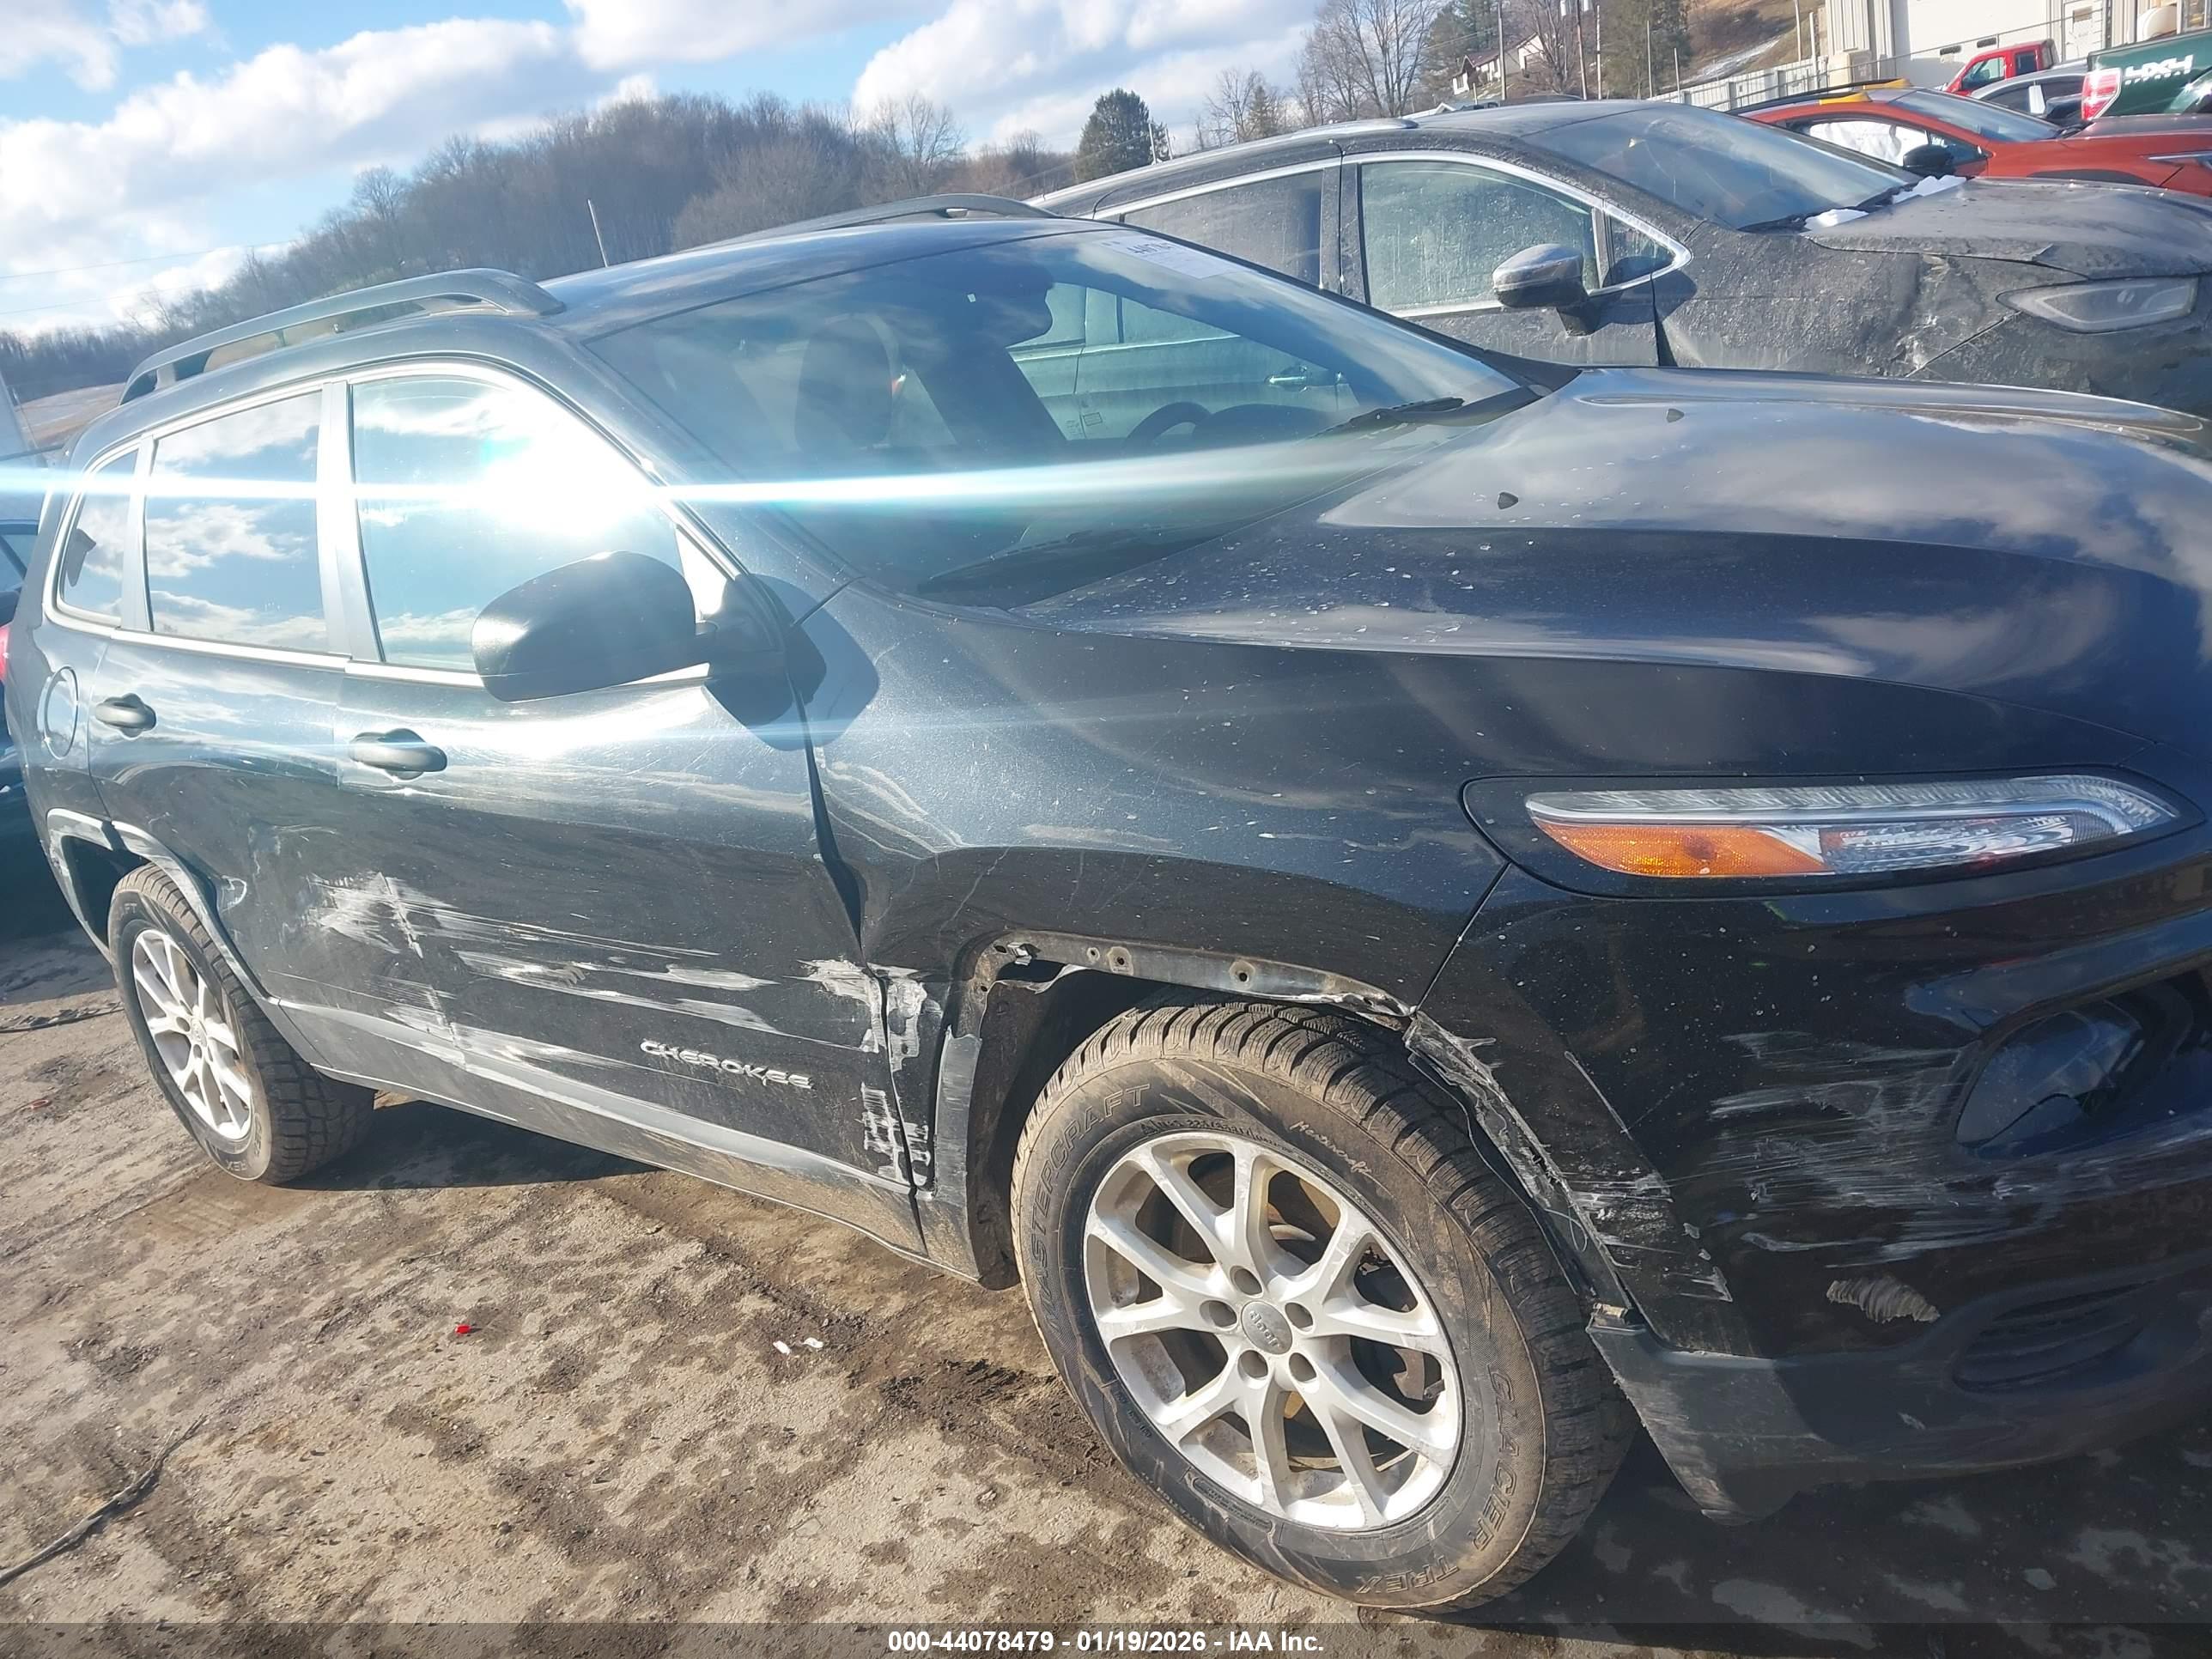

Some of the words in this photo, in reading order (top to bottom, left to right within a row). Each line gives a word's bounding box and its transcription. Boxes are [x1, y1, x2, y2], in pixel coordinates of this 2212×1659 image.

[640, 1039, 816, 1091] CHEROKEE
[1030, 1083, 1151, 1334] MASTERCRAFT
[1249, 1310, 1285, 1351] Jeep
[1471, 1363, 1521, 1551] GLACIER
